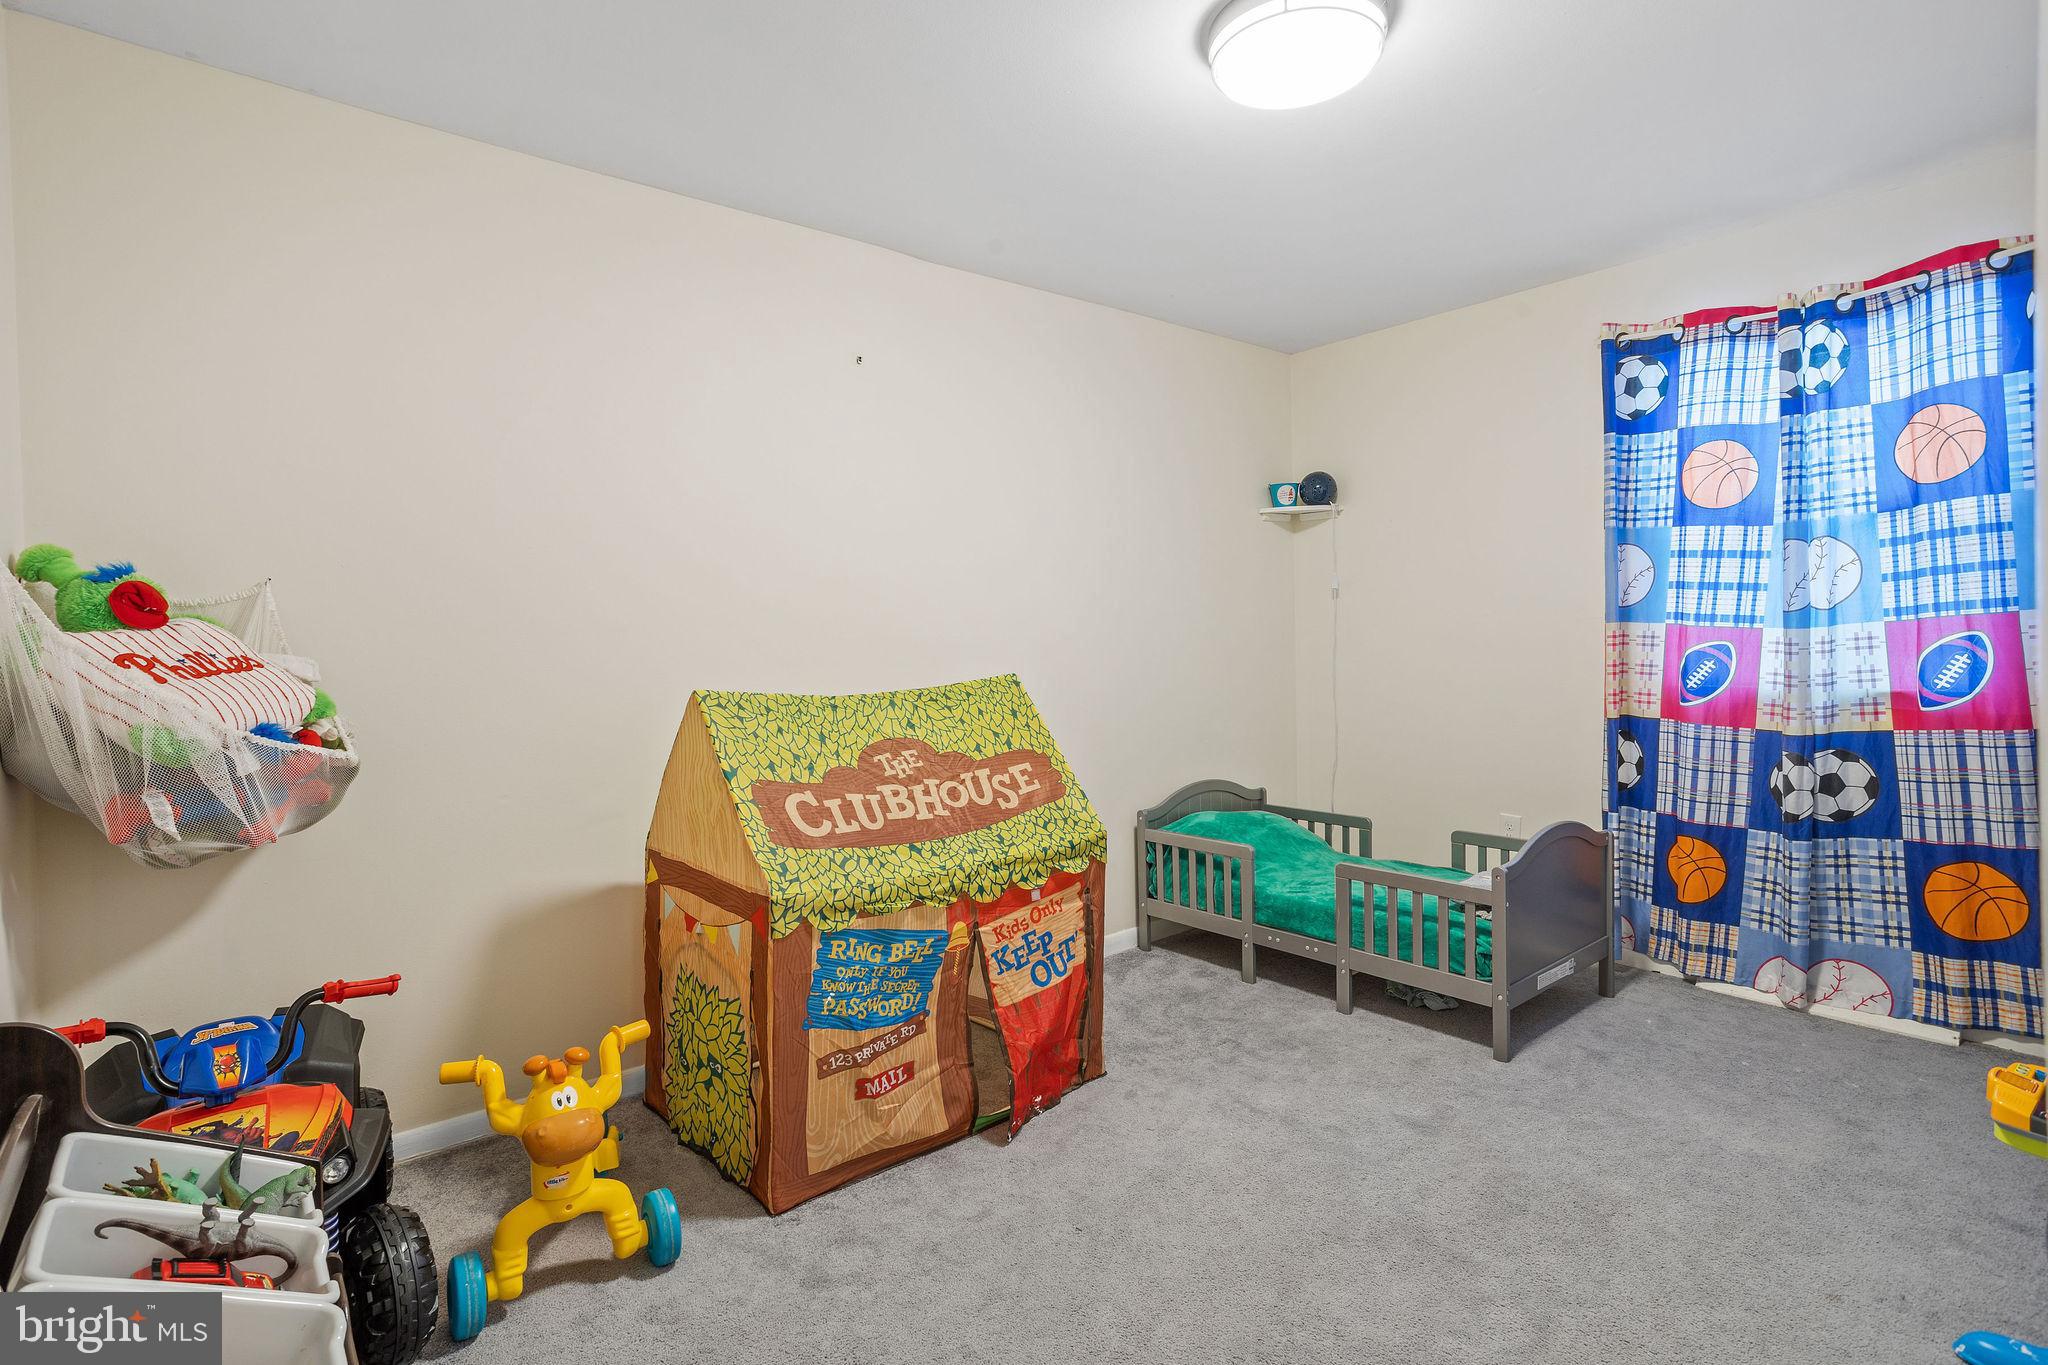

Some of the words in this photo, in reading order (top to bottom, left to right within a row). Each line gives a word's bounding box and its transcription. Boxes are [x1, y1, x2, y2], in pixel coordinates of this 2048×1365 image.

[113, 651, 264, 684] Phillies
[874, 749, 924, 779] THE
[784, 762, 1041, 837] CLUBHOUSE
[992, 917, 1029, 944] Kids
[1029, 897, 1064, 924] Only
[828, 938, 883, 963] RING
[888, 938, 935, 963] BELL
[991, 929, 1053, 976] KEEP
[1030, 930, 1078, 987] OUT
[821, 979, 856, 993] KNOW
[858, 979, 880, 996] THE
[880, 979, 920, 993] SECRET
[836, 965, 869, 979] ONLY
[872, 966, 887, 977] IF
[888, 966, 909, 979] YOU
[821, 992, 922, 1020] PASSWORD!
[829, 1053, 853, 1069] 123
[854, 1034, 898, 1063] PRIVATE
[900, 1024, 917, 1038] RD
[864, 1067, 907, 1095] MAIL
